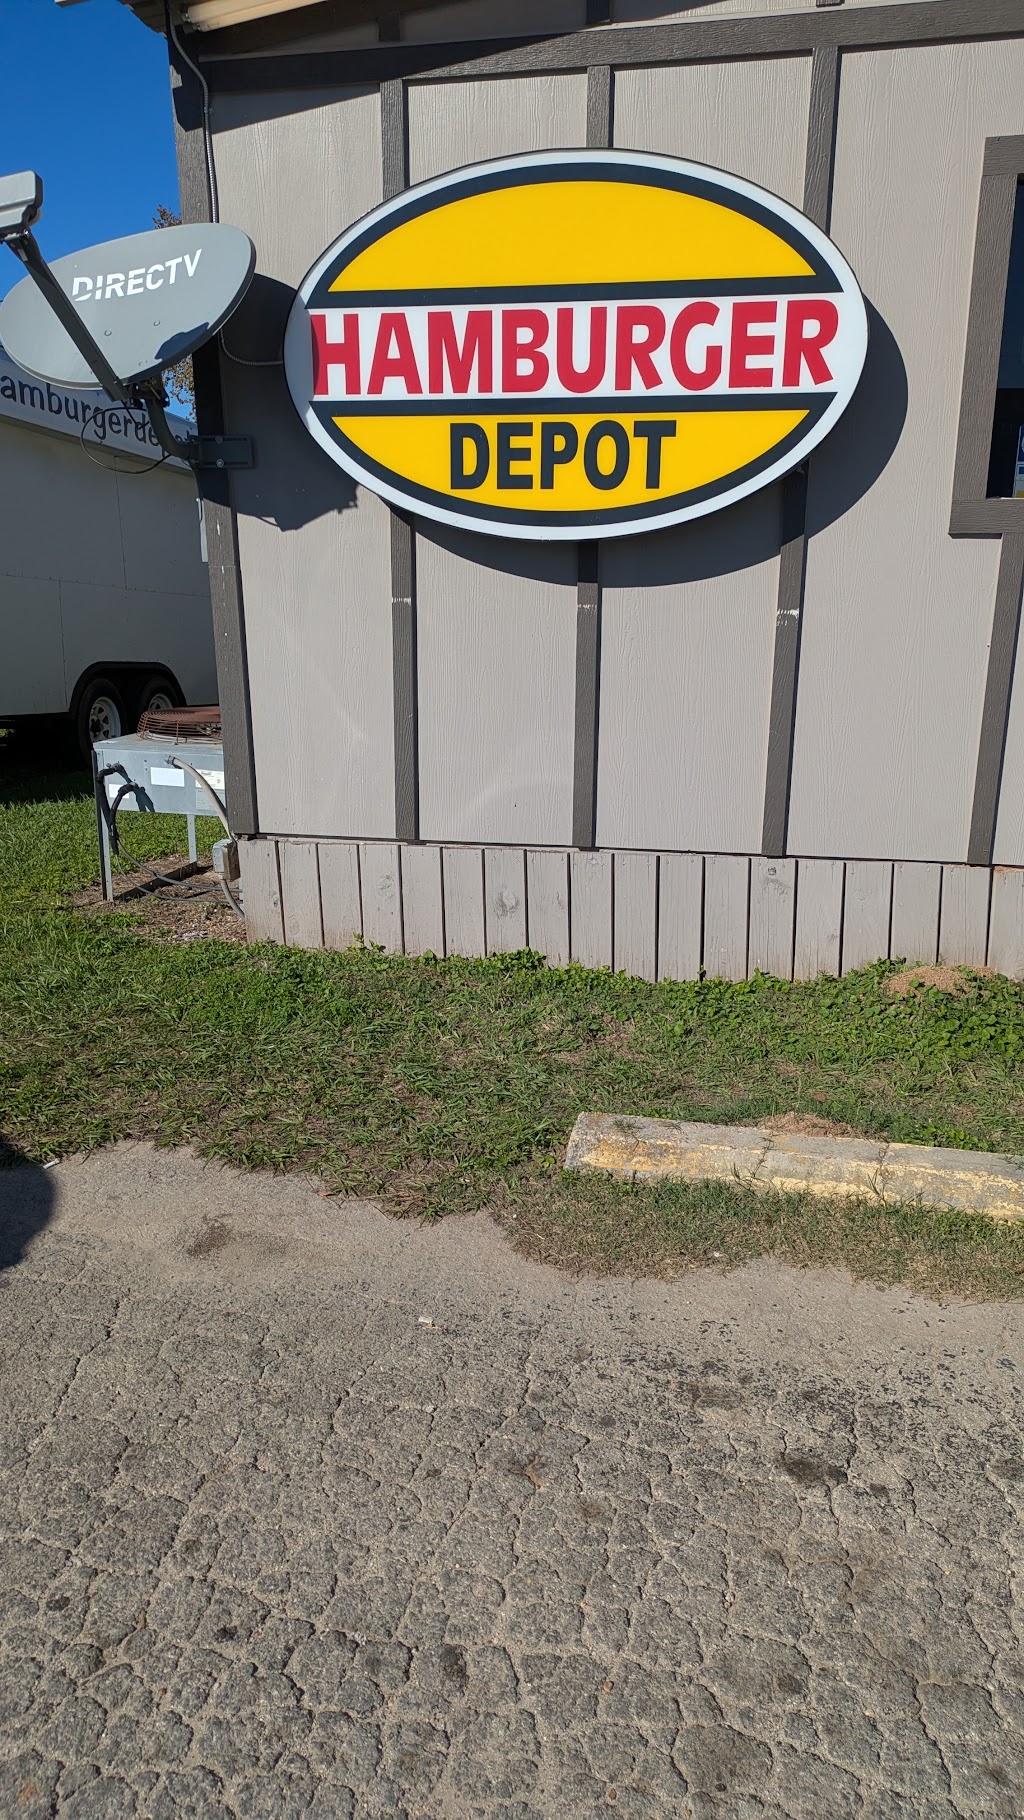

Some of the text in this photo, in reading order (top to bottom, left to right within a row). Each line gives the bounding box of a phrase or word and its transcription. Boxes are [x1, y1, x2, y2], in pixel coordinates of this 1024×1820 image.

[71, 249, 202, 302] DIRECTV
[310, 299, 840, 396] HAMBURGER
[449, 420, 677, 490] DEPOT
